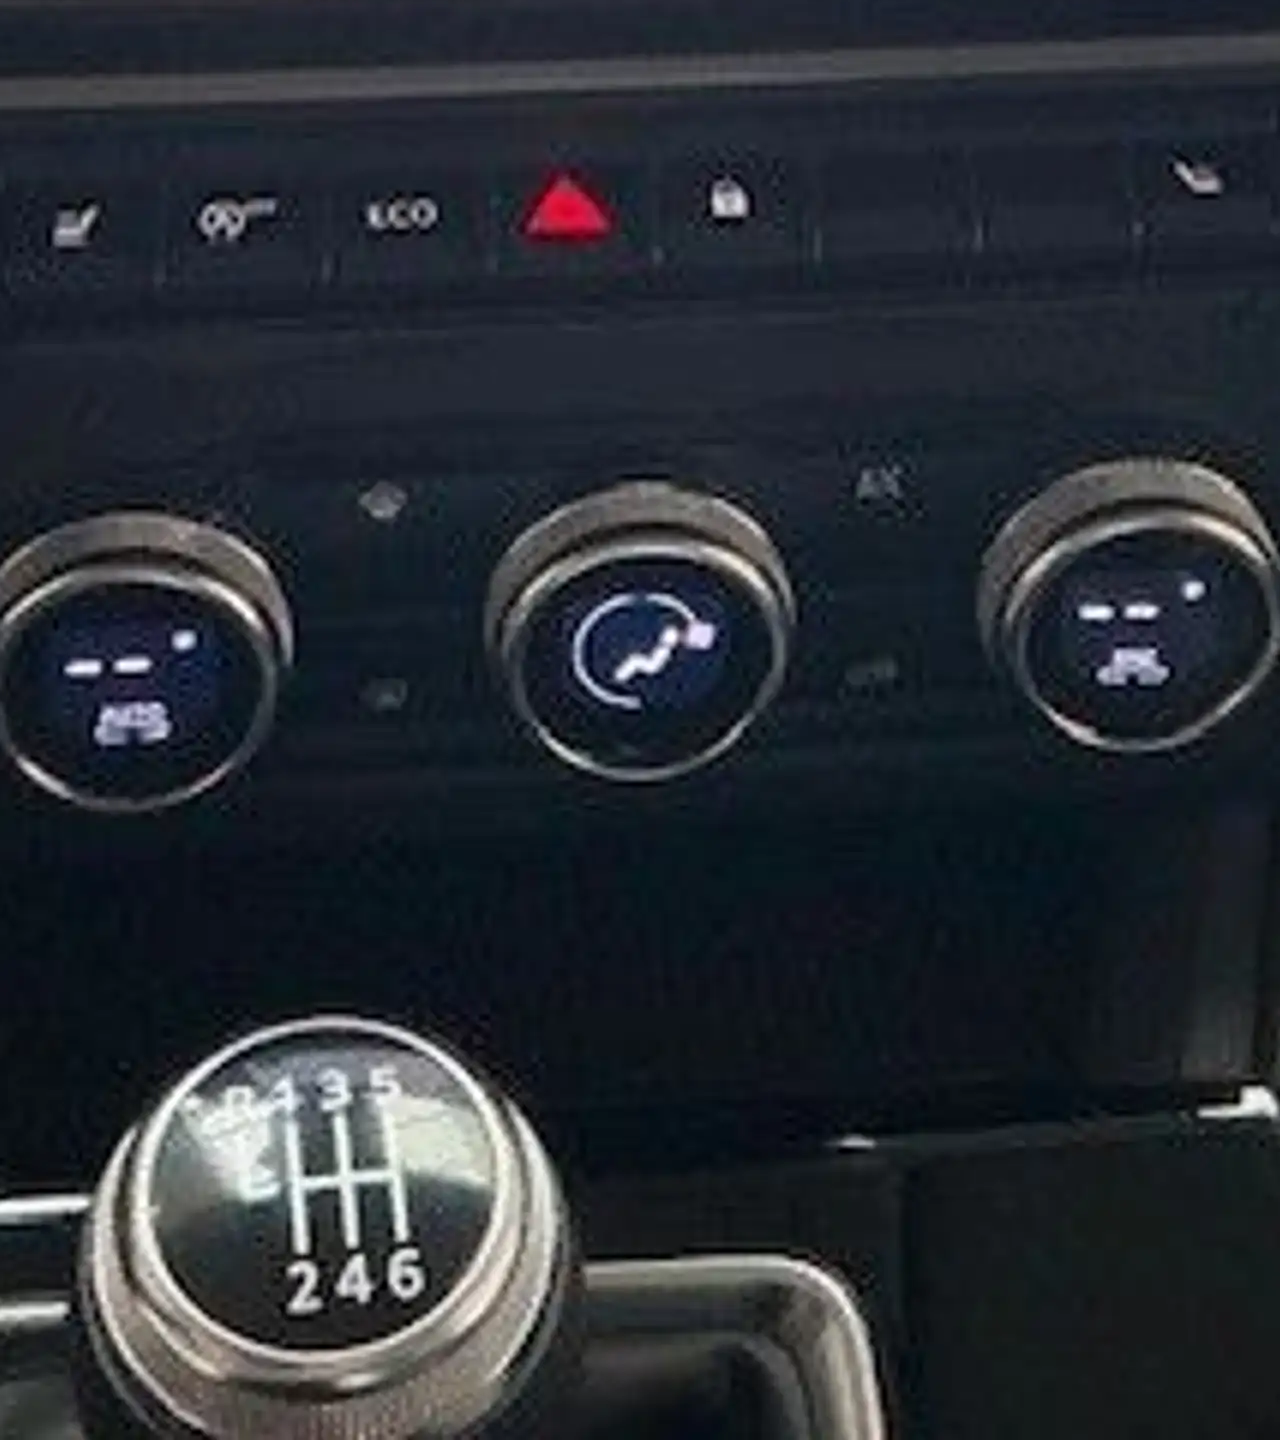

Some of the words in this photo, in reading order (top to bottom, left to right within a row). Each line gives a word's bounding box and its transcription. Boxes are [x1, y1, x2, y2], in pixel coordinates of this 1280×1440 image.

[368, 197, 439, 231] ECO
[320, 1067, 352, 1112] 3
[366, 1065, 404, 1109] 5
[286, 1261, 323, 1315] 2
[334, 1254, 375, 1304] 4
[387, 1248, 426, 1301] 6
